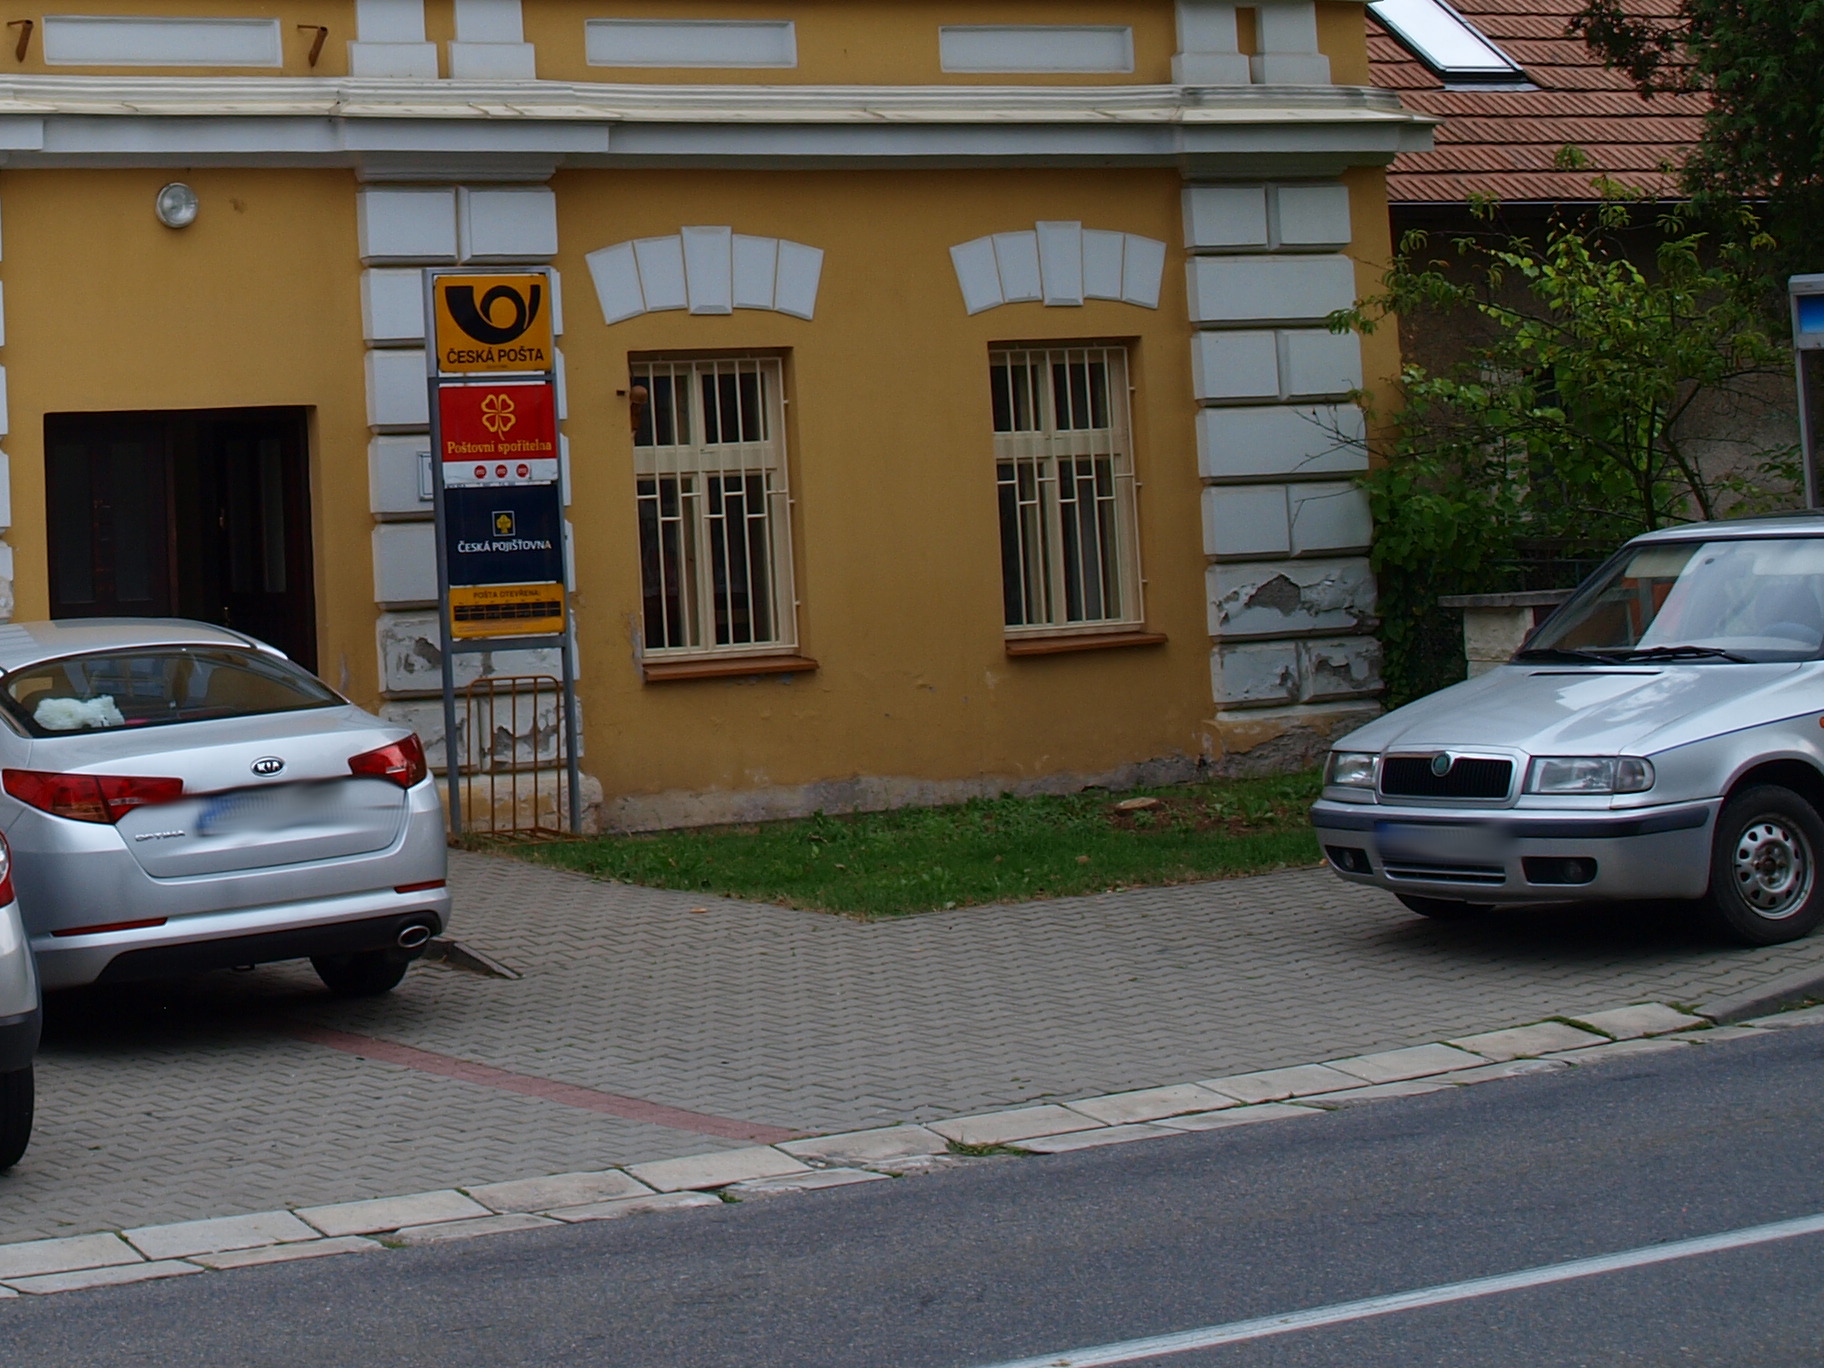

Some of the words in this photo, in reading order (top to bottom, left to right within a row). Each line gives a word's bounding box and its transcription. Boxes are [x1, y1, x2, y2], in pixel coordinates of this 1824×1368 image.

[447, 348, 495, 364] ČESKÁ
[498, 345, 544, 362] POŠTA
[447, 440, 495, 454] Poštovní
[498, 439, 552, 455] spořitelna
[457, 540, 491, 553] ČESKÁ
[492, 539, 552, 552] POJIŠŤOVNA
[473, 591, 498, 599] POŠTA
[256, 760, 281, 773] KIA
[134, 830, 186, 842] OPTIMA
